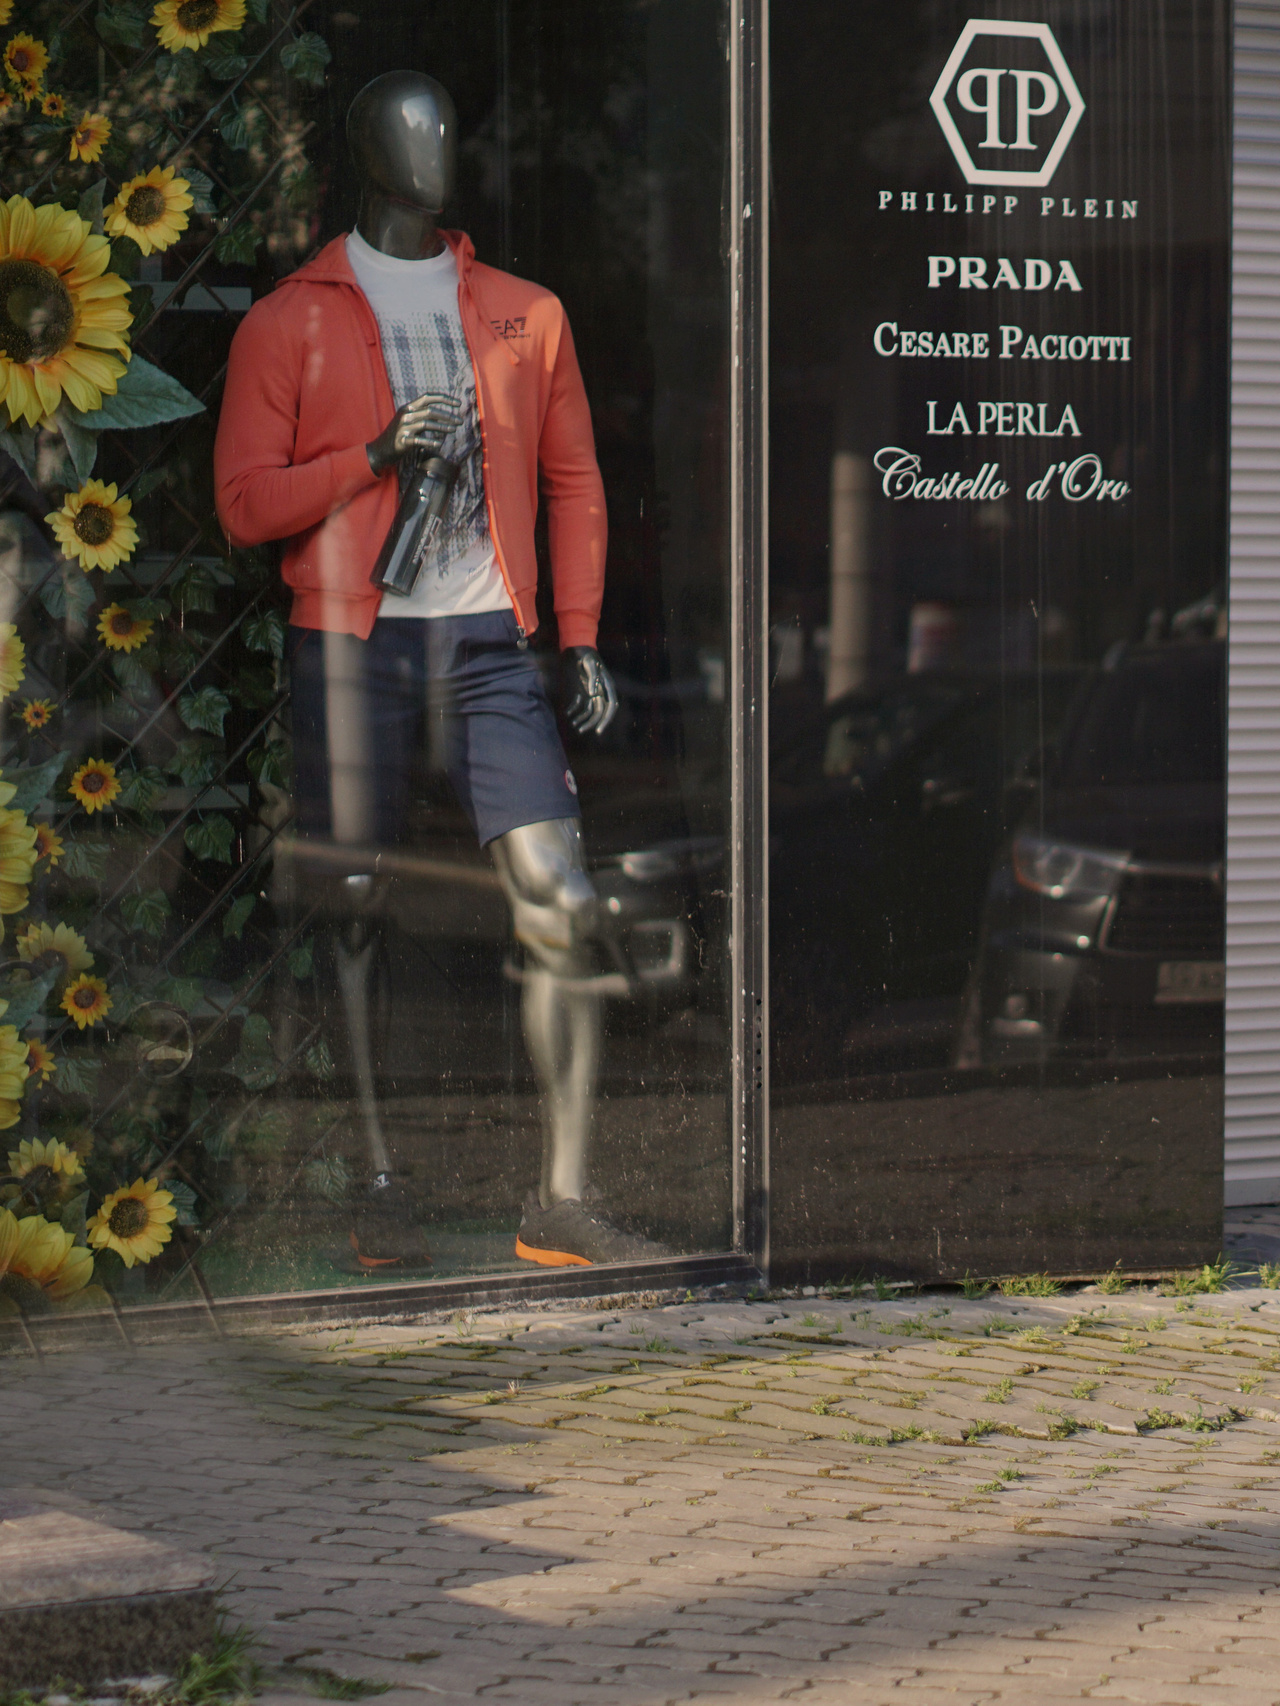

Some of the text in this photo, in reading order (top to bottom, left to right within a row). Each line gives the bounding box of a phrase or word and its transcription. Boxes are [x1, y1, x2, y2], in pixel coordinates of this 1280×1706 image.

[878, 190, 1138, 218] PHILIPP PLEIN
[927, 256, 1083, 292] PRADA
[873, 322, 1131, 361] CESARE PACIOTTI
[927, 401, 1082, 437] LA PERLA
[874, 446, 1131, 501] Castello d'Oro
